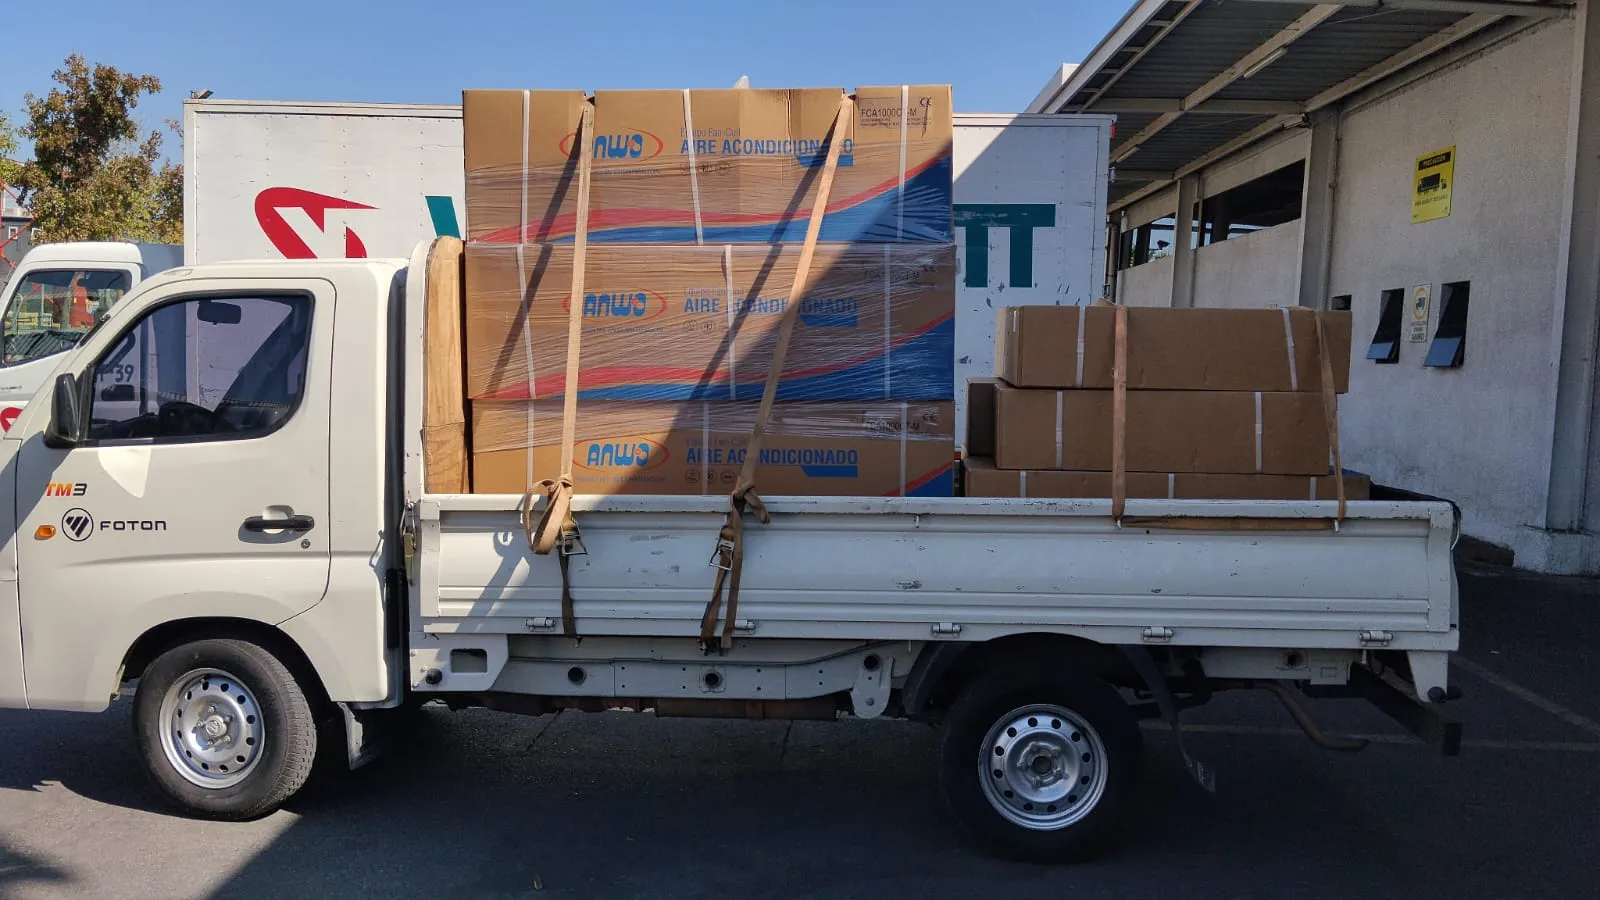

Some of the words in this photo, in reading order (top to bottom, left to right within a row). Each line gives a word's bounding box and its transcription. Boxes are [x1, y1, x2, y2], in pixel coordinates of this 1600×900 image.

[861, 108, 917, 118] FCA1000C-M
[593, 134, 643, 158] NWO
[721, 138, 854, 155] ACONDICIONAO
[584, 293, 647, 316] ANWO
[684, 298, 721, 313] AIRE
[726, 297, 858, 314] CONDIONADO
[587, 443, 649, 466] ANWO
[727, 447, 858, 464] ACNDICIONADO
[46, 483, 88, 497] TM3
[100, 520, 167, 531] FOTON
